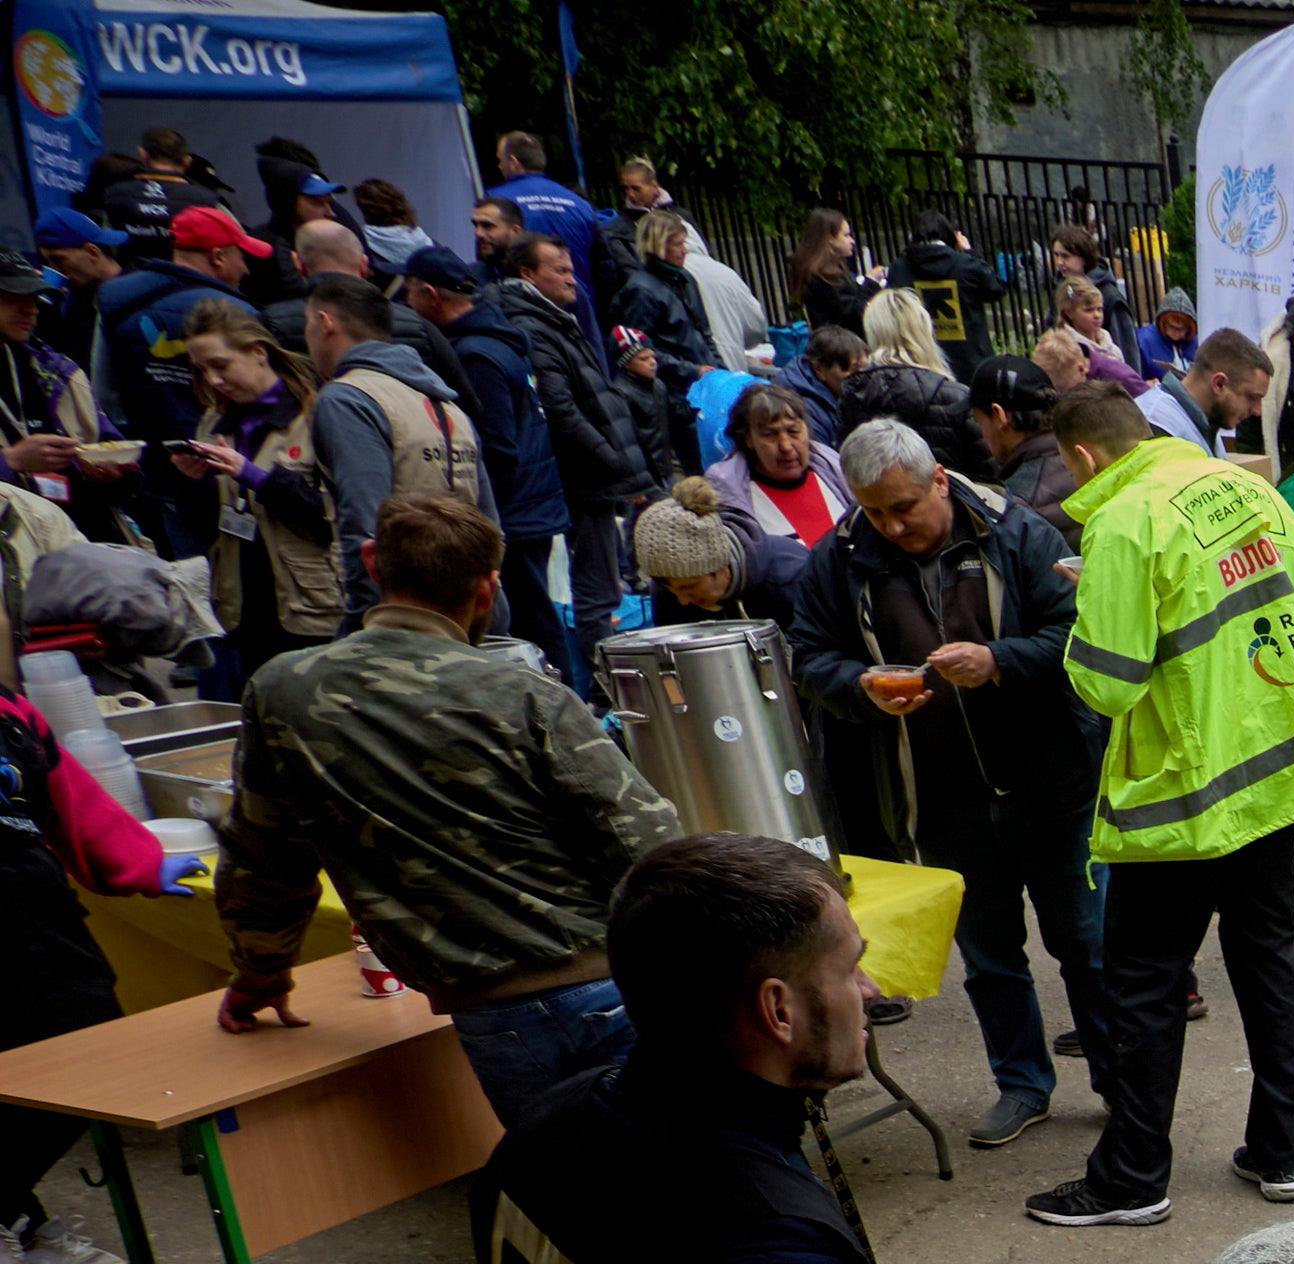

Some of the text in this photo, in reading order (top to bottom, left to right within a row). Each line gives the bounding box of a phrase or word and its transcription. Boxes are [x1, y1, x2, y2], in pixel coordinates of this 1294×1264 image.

[97, 21, 308, 87] WCK.org
[1215, 276, 1281, 295] ХАРКІВ
[1184, 488, 1222, 515] ГРУПА
[1219, 538, 1280, 588] ВОЛО
